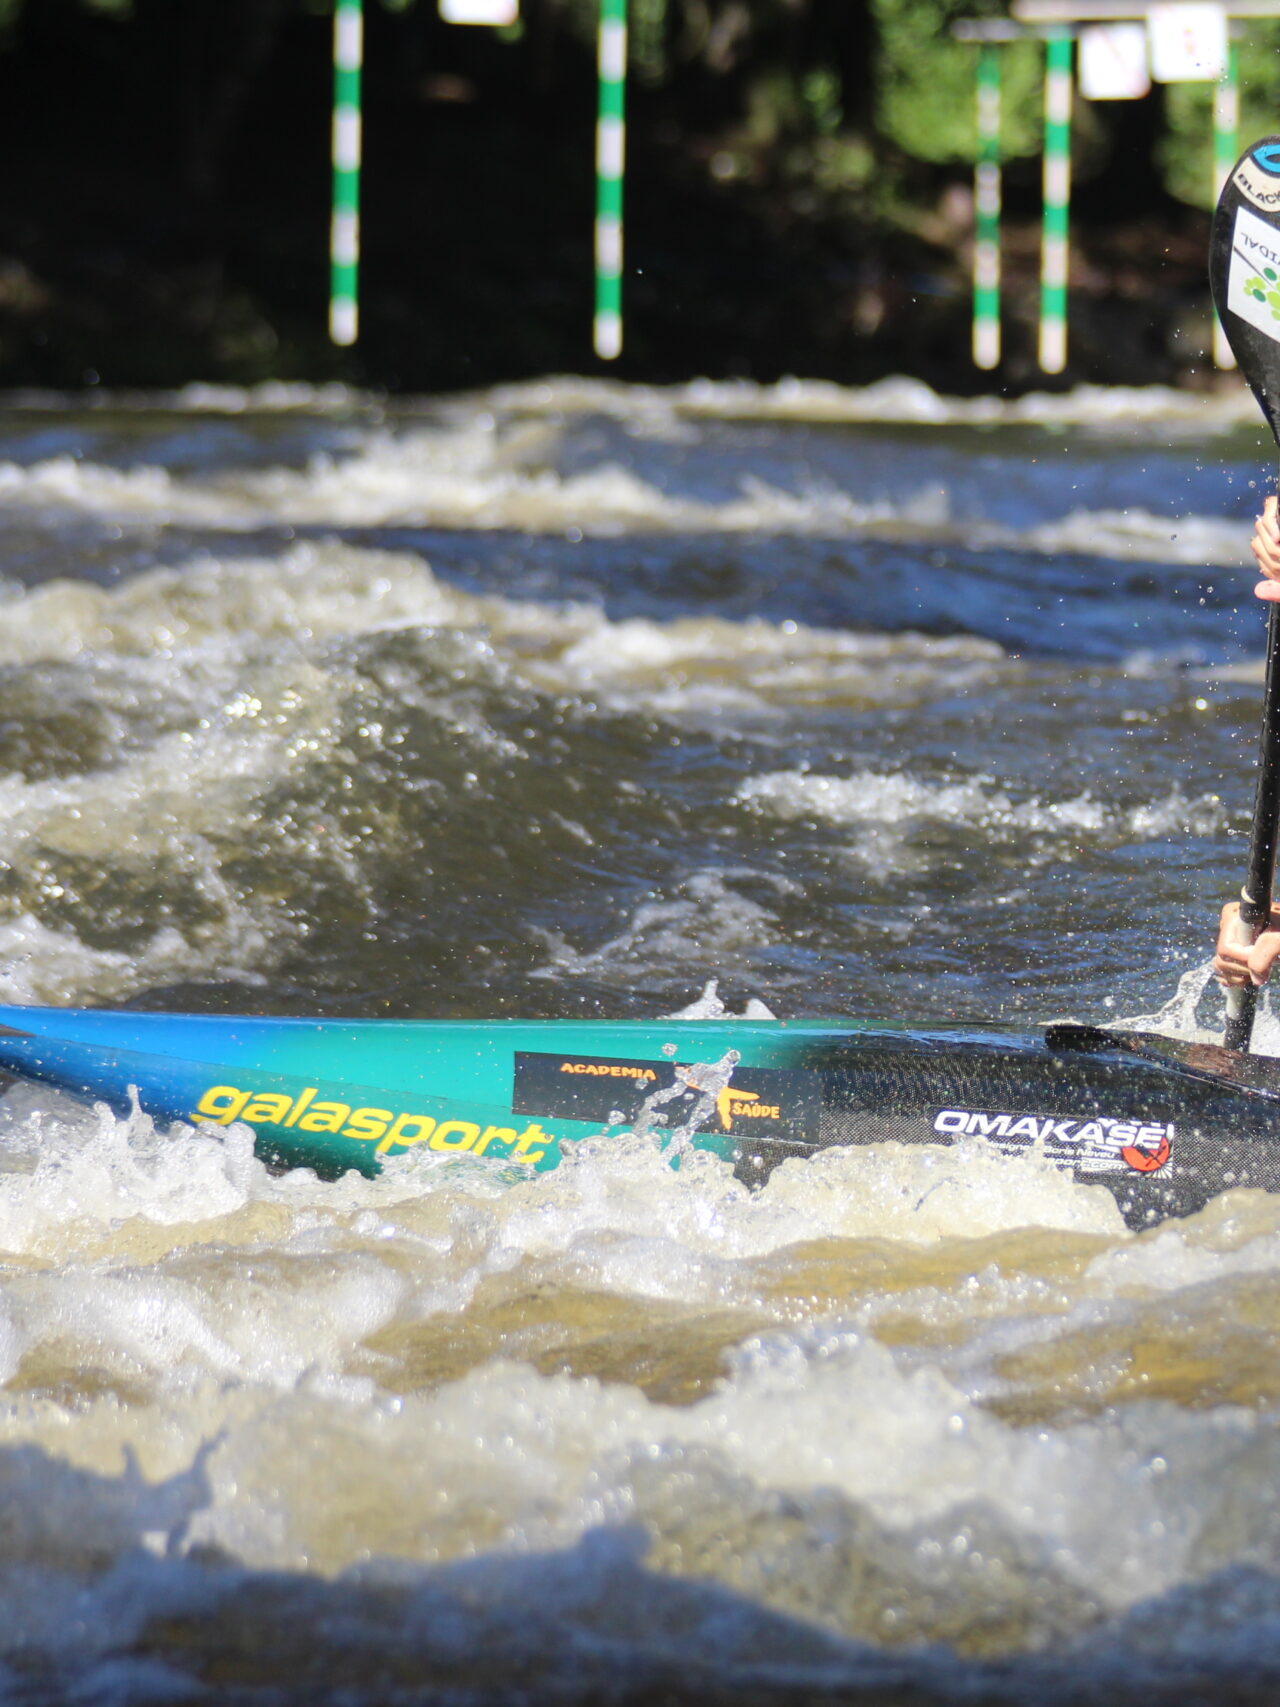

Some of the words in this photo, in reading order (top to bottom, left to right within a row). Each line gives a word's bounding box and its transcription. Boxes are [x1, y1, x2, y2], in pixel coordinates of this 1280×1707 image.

[561, 1062, 656, 1081] ACADEMIA
[732, 1101, 781, 1120] SAÚDE
[190, 1085, 554, 1163] galasport
[934, 1110, 1166, 1149] OMAKASE
[1077, 1148, 1116, 1159] Neveu
